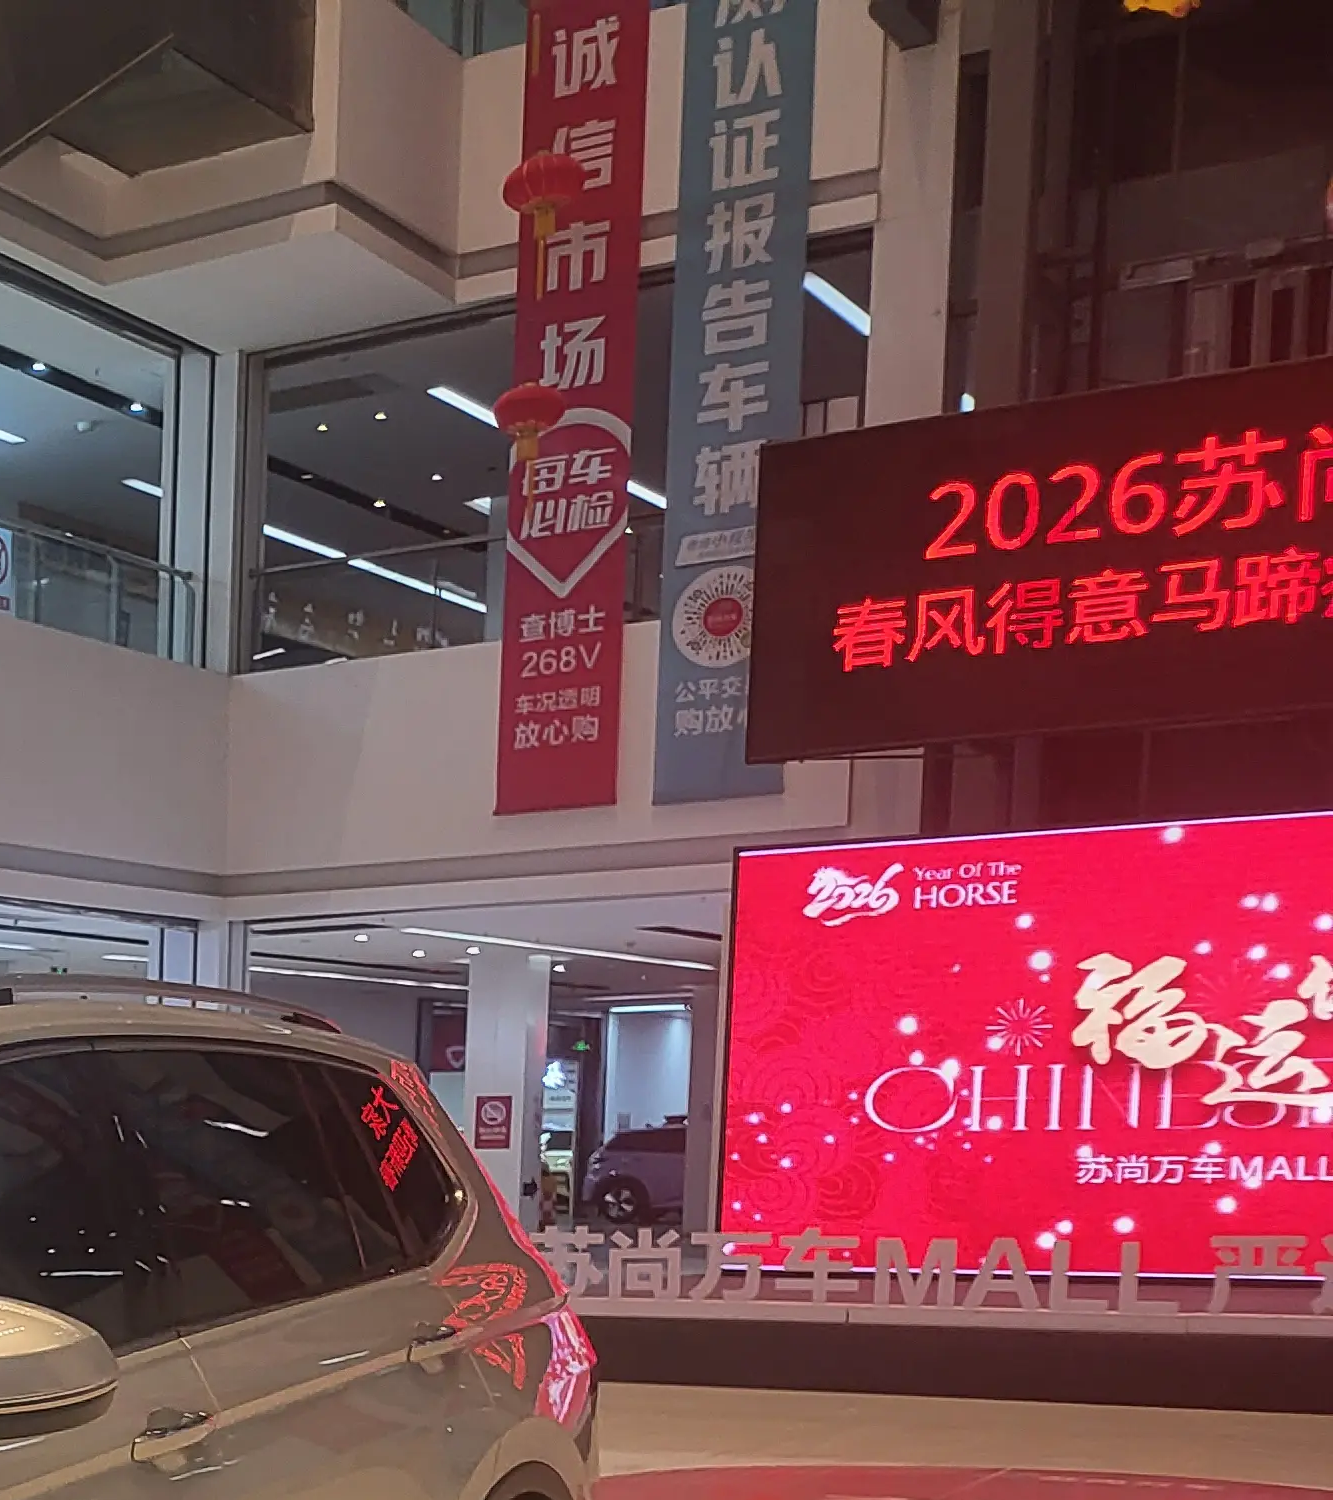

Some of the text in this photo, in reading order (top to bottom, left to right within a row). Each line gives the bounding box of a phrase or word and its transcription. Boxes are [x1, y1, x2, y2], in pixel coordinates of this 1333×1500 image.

[538, 15, 620, 391] 诚信市场
[520, 604, 606, 643] 查博士
[833, 546, 1333, 673] 春风得意马蹄
[520, 641, 602, 679] 268V
[514, 685, 602, 716] 车况透明
[674, 676, 749, 703] 公平交
[513, 713, 600, 750] 放心购
[673, 704, 746, 738] 购放
[912, 861, 1022, 882] Year Of The
[912, 880, 1018, 909] HORSE
[1206, 1232, 1333, 1314] 严
